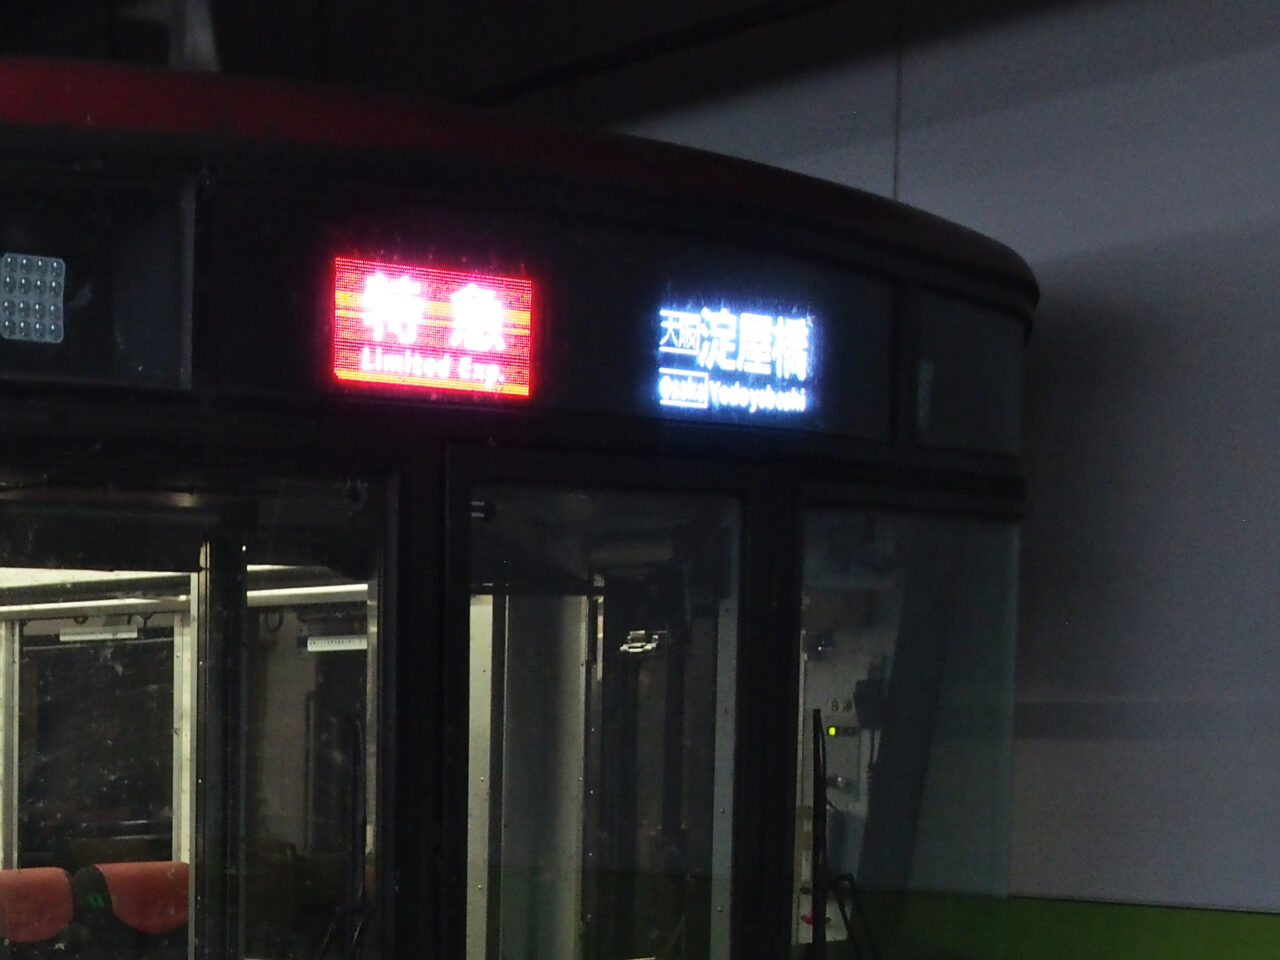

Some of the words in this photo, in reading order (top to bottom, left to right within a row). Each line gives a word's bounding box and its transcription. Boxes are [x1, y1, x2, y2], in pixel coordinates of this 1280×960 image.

[362, 272, 506, 351] 特急
[698, 307, 809, 380] 淀屋橋
[361, 347, 450, 378] Limited
